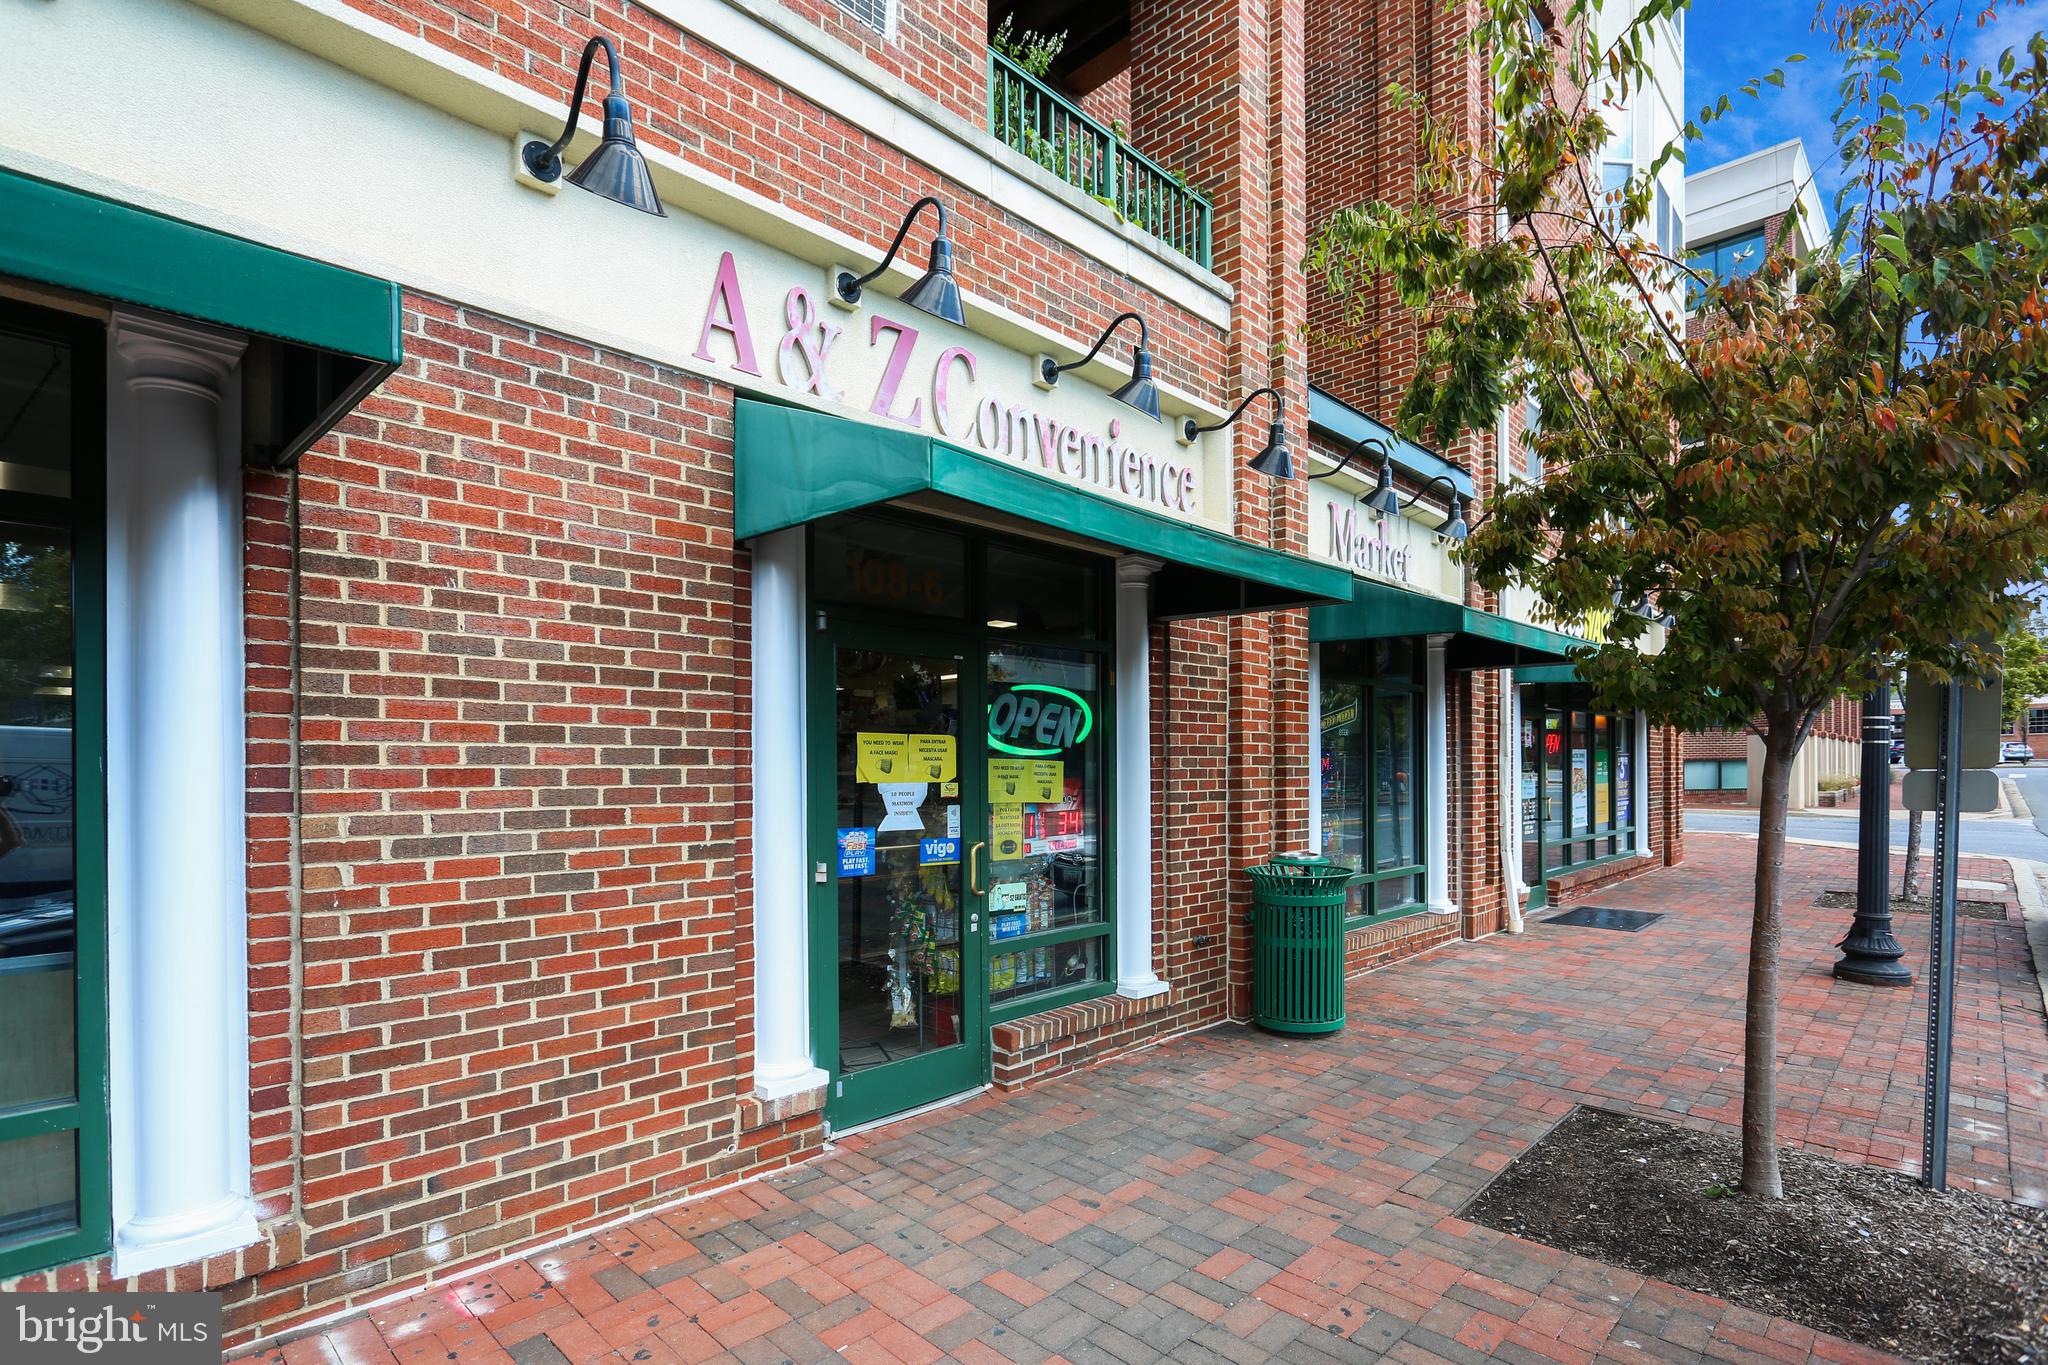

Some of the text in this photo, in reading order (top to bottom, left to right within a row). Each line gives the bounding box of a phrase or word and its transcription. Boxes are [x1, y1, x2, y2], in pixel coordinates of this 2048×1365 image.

[691, 250, 1196, 515] A & Z Convenience
[1327, 501, 1412, 583] Market
[988, 693, 1083, 749] OPEN
[925, 840, 955, 857] vigo
